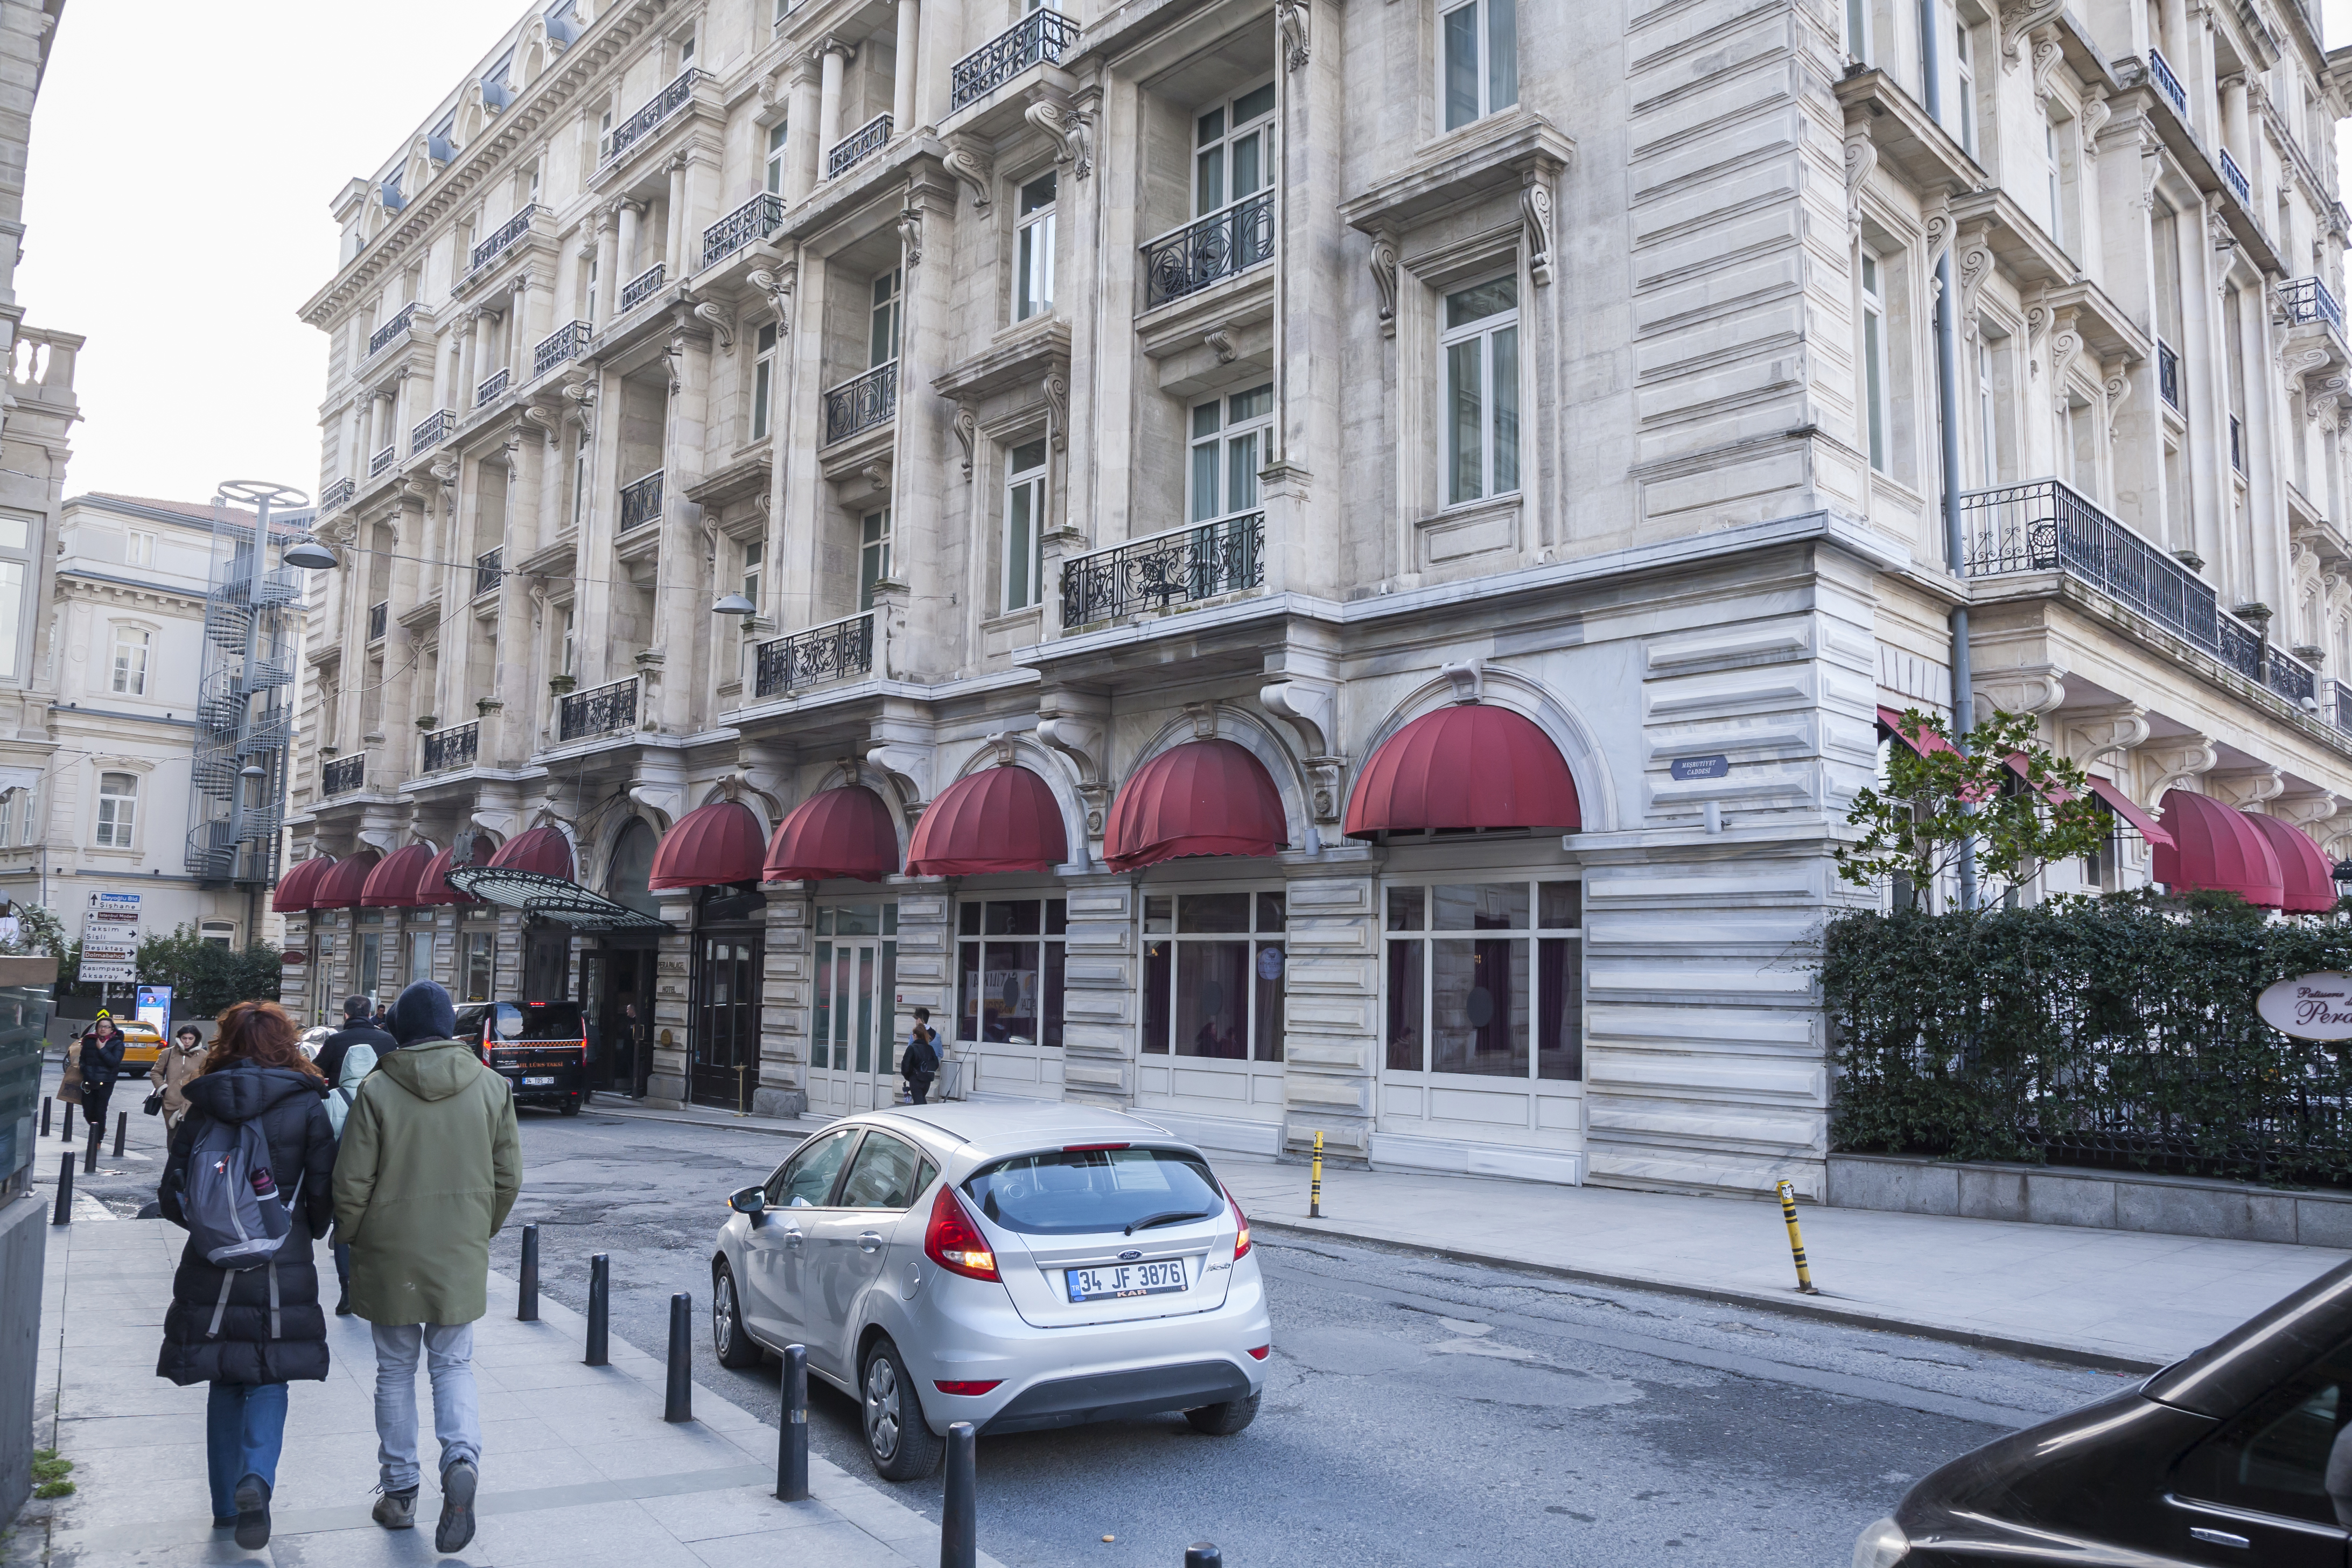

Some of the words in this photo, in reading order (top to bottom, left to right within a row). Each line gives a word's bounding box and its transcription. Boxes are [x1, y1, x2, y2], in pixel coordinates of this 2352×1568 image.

[1682, 760, 1716, 768] MEŞRUTİYET
[1687, 767, 1711, 775] CADDESİ
[658, 961, 669, 969] PERA
[669, 961, 684, 969] PALACE
[2297, 987, 2344, 998] Patisserie
[1079, 1271, 1102, 1292] 34
[1112, 1268, 1130, 1289] JF
[1138, 1263, 1180, 1286] 3876
[1117, 1289, 1147, 1297] KAR
